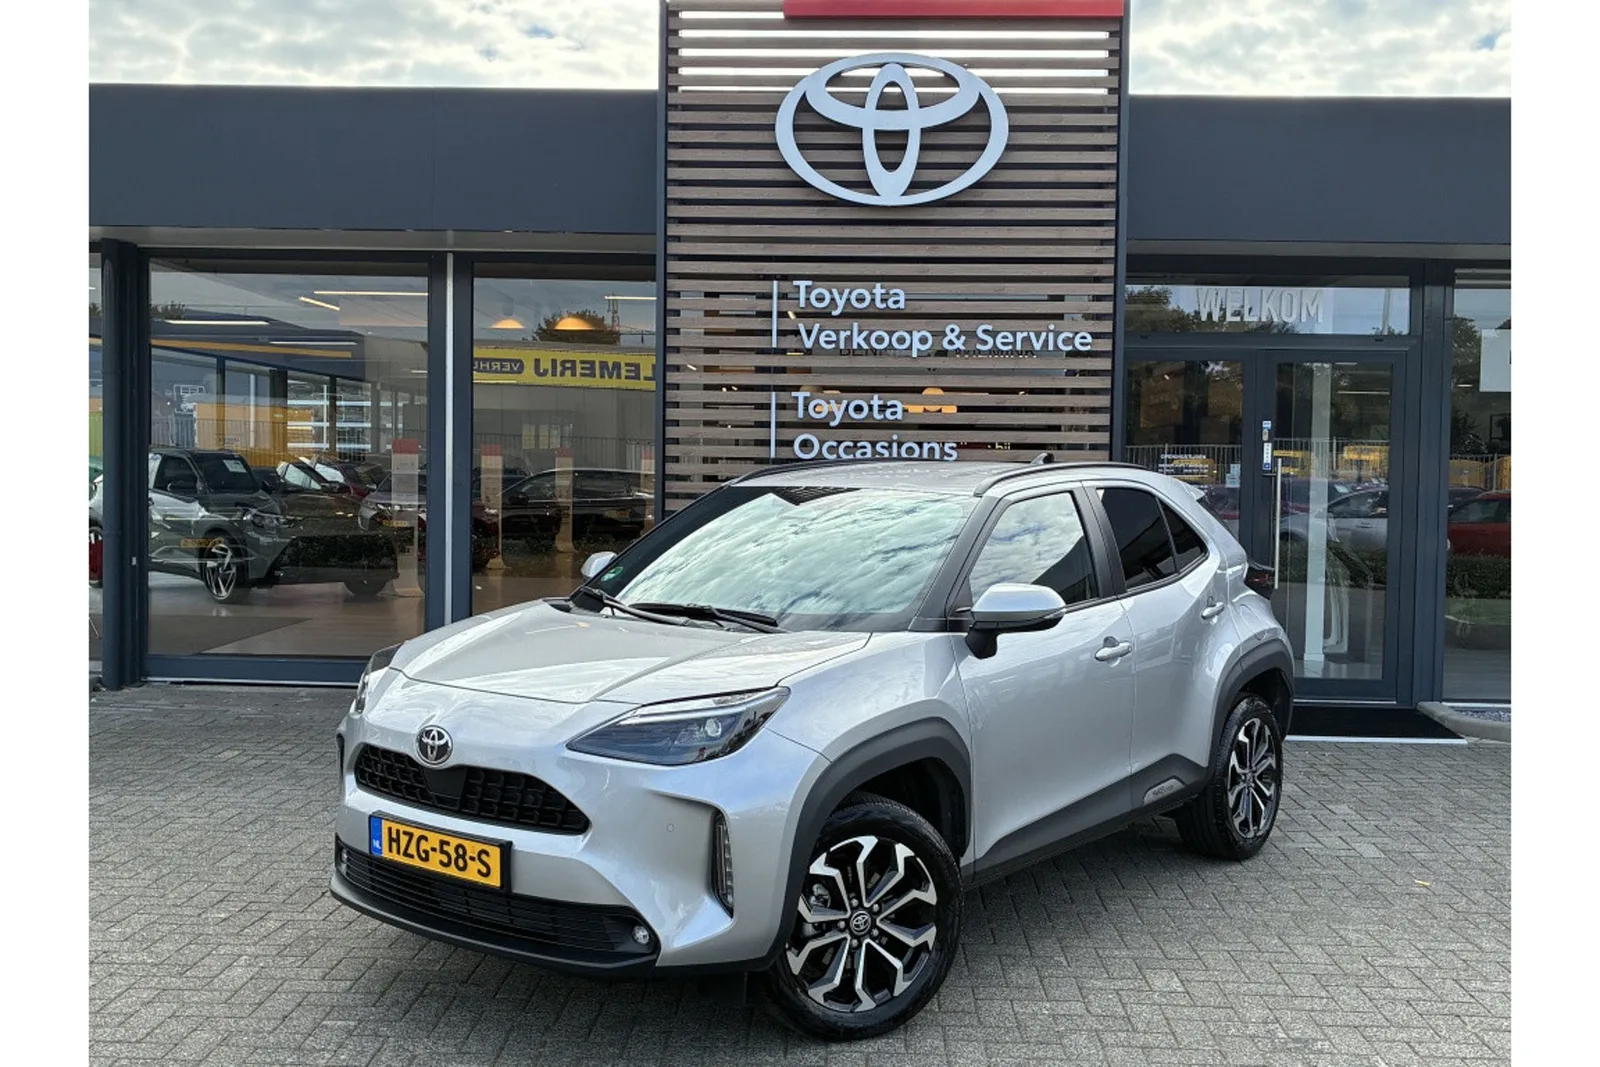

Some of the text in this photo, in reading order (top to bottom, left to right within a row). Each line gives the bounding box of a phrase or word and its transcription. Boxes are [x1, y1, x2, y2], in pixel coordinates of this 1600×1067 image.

[792, 280, 906, 316] Toyota
[1196, 287, 1324, 323] WELKOM
[797, 321, 1093, 358] Verkoop & Service
[791, 391, 904, 427] Toyota
[792, 433, 958, 462] Occasions
[387, 826, 492, 878] HZG-58-S
